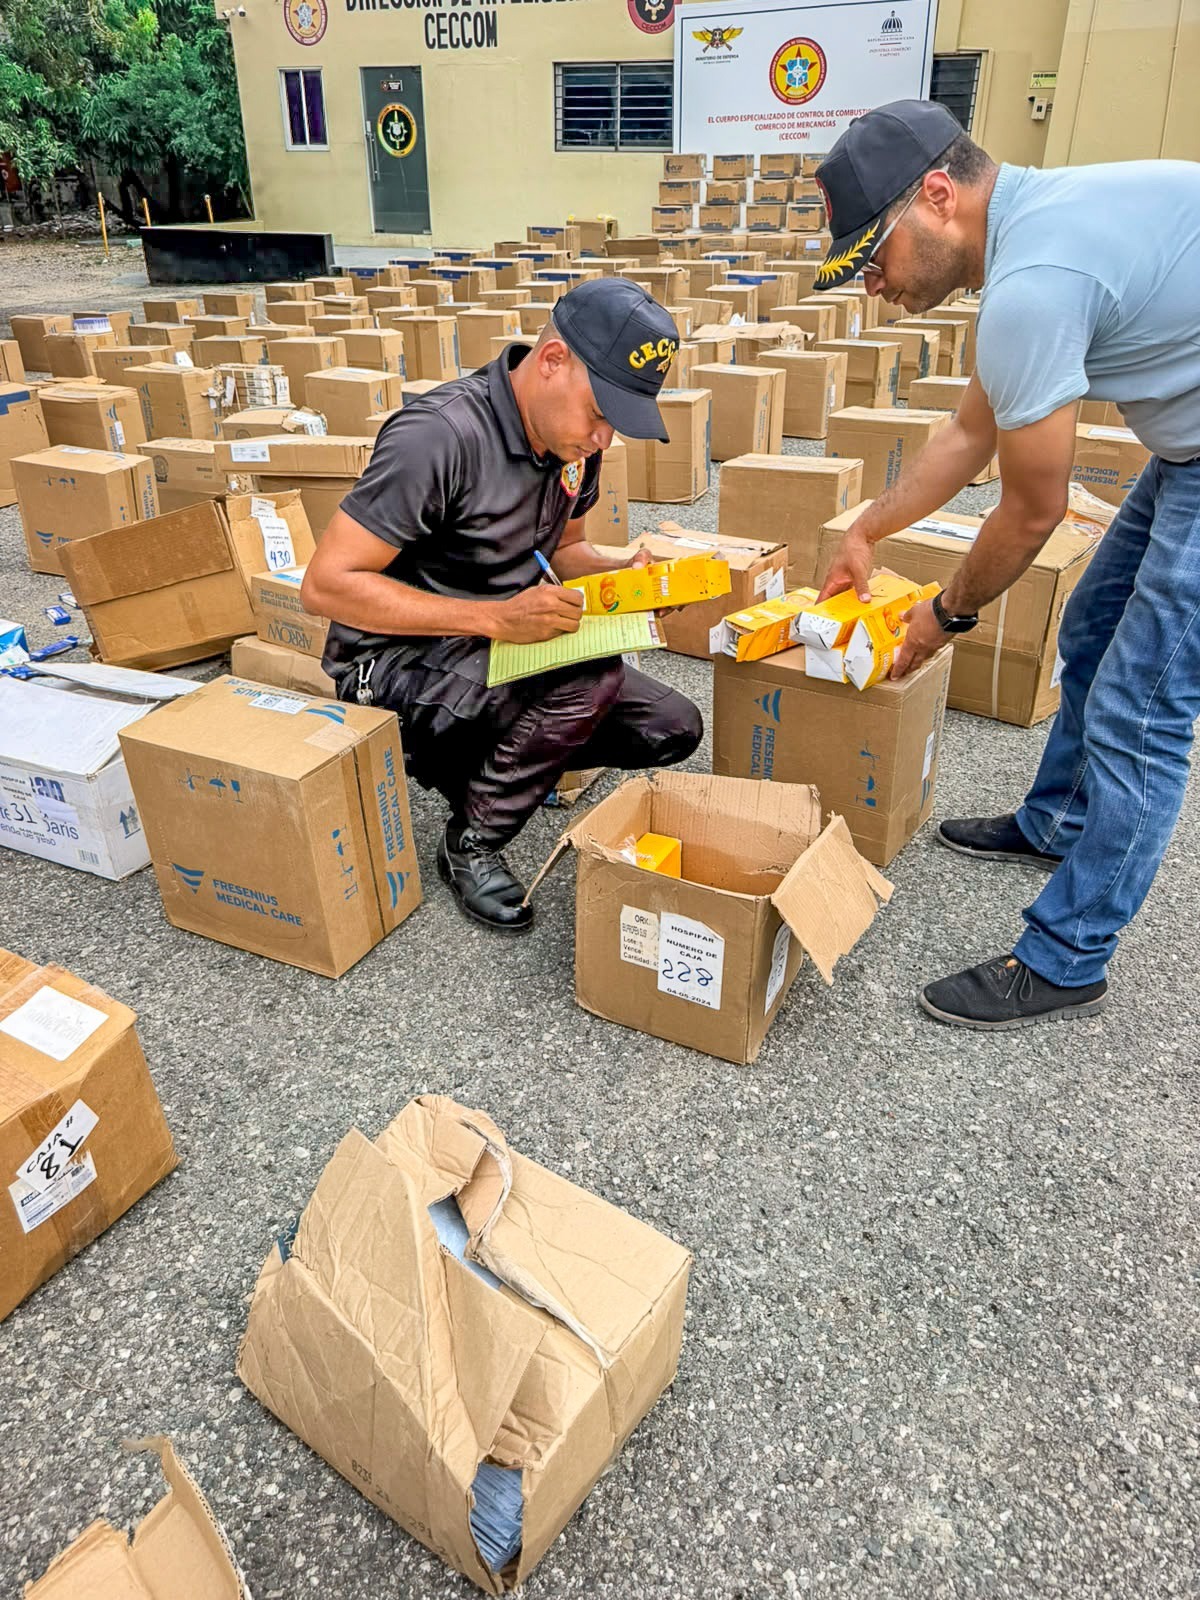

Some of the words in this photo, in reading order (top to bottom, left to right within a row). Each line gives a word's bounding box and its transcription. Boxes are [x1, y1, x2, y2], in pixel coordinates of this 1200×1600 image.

[424, 11, 498, 49] CECCOM
[715, 115, 739, 123] CUERPO
[740, 112, 786, 122] ESPECIALIZADO
[787, 111, 795, 119] DE
[796, 110, 825, 119] CONTROL
[826, 109, 834, 117] DE
[754, 122, 786, 131] COMERCIO
[797, 119, 836, 129] MERCANCÍAS
[779, 131, 810, 141] (CECCOM)
[1073, 474, 1118, 486] FRESENIUS
[1085, 466, 1119, 477] MEDICAL
[270, 550, 291, 569] 430
[268, 624, 313, 650] ARROW
[750, 724, 762, 776] MEDICAL
[763, 727, 775, 780] FRESENI
[384, 746, 397, 787] CARE
[10, 802, 37, 825] 31
[377, 781, 396, 862] FRESENIUS
[389, 789, 405, 853] MEDICAL
[212, 879, 279, 907] FRESENIUS
[215, 891, 269, 916] MEDICAL
[270, 908, 304, 927] CARE
[671, 925, 714, 943] HOSPIFAR
[666, 938, 704, 955] NUMERO
[705, 951, 717, 960] DE
[679, 950, 703, 962] CAJA
[662, 958, 714, 987] 228
[26, 1132, 63, 1174] CAJA
[40, 1135, 84, 1180] 81
